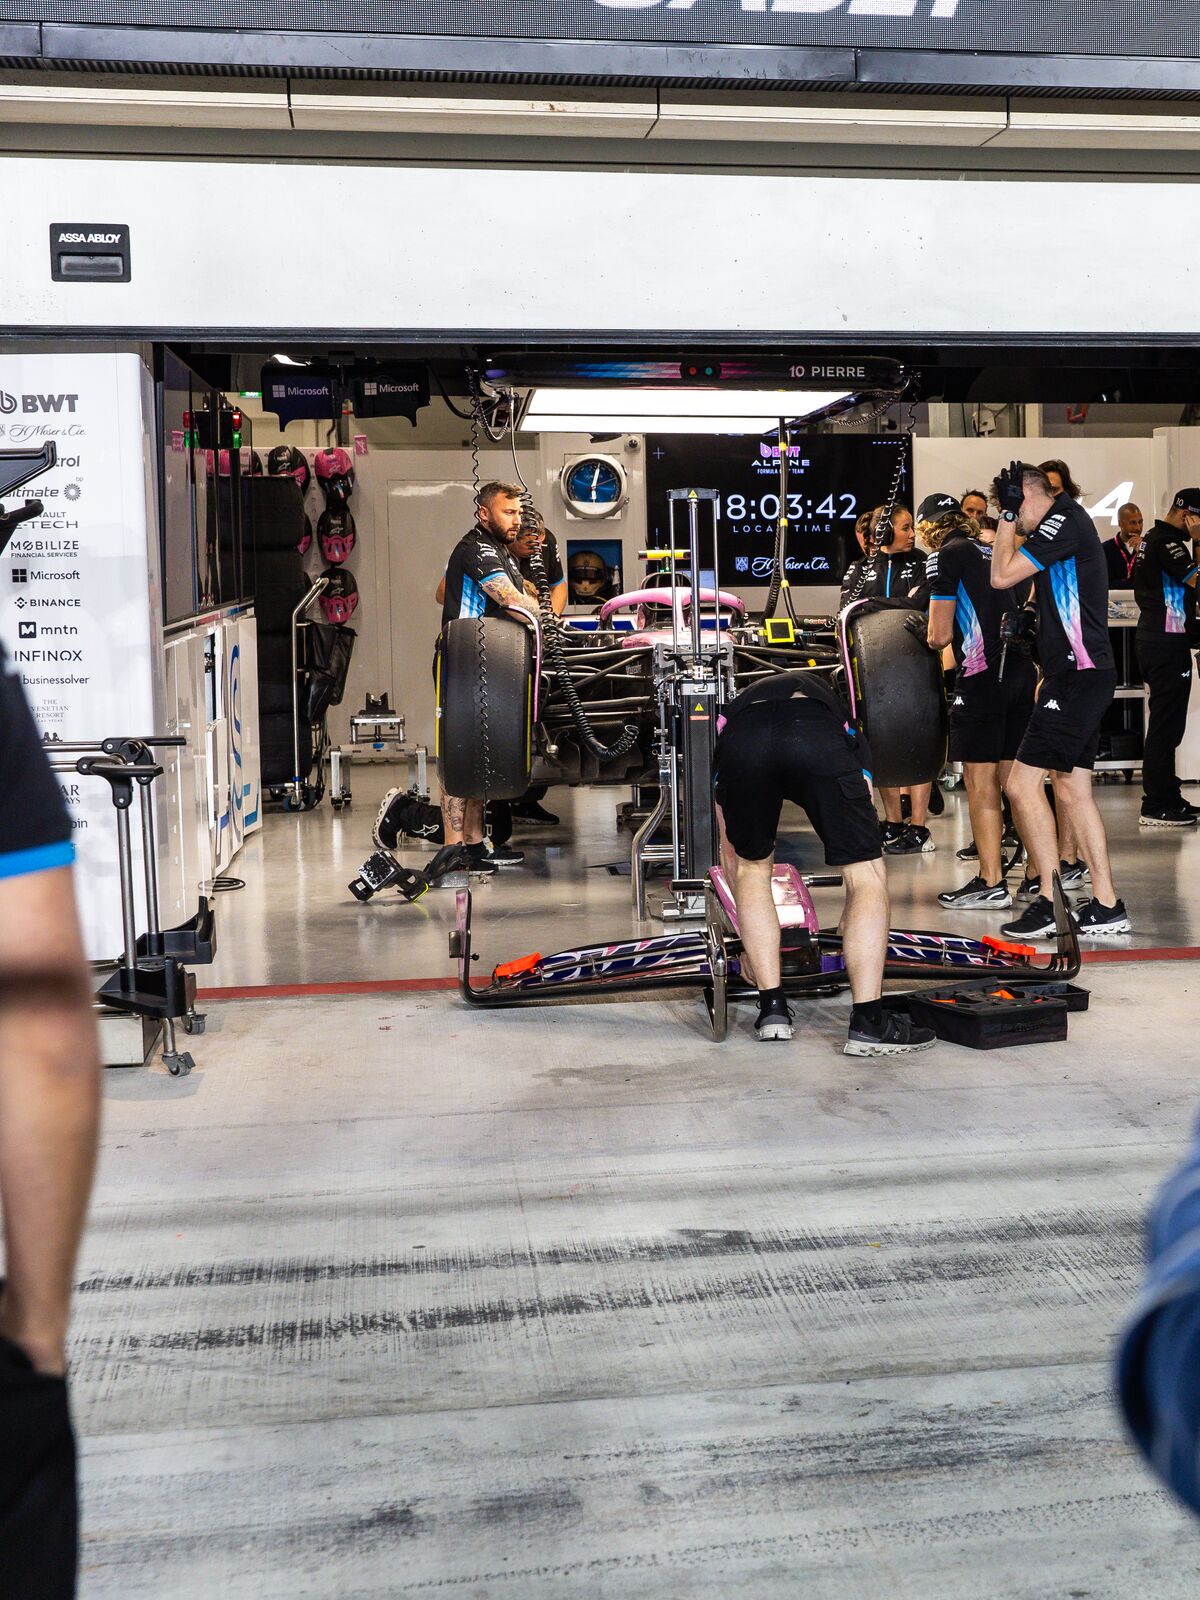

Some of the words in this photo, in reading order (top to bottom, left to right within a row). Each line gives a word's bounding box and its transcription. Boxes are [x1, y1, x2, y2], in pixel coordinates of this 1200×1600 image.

[59, 233, 87, 243] ASSA
[87, 233, 121, 243] ABLOY
[789, 365, 805, 377] 10
[811, 366, 865, 377] PIERRE
[287, 387, 329, 396] Microsoft
[379, 382, 419, 393] Microsoft
[22, 394, 79, 413] BWT
[751, 459, 810, 467] ALPNE
[716, 493, 857, 520] 18:03:42
[733, 525, 774, 533] LOCA
[794, 525, 831, 533] TIME
[30, 570, 80, 580] Microsoft
[30, 599, 81, 607] BINANCE
[41, 625, 78, 635] mntn
[15, 650, 82, 661] INFINOX
[23, 674, 90, 685] businessolver
